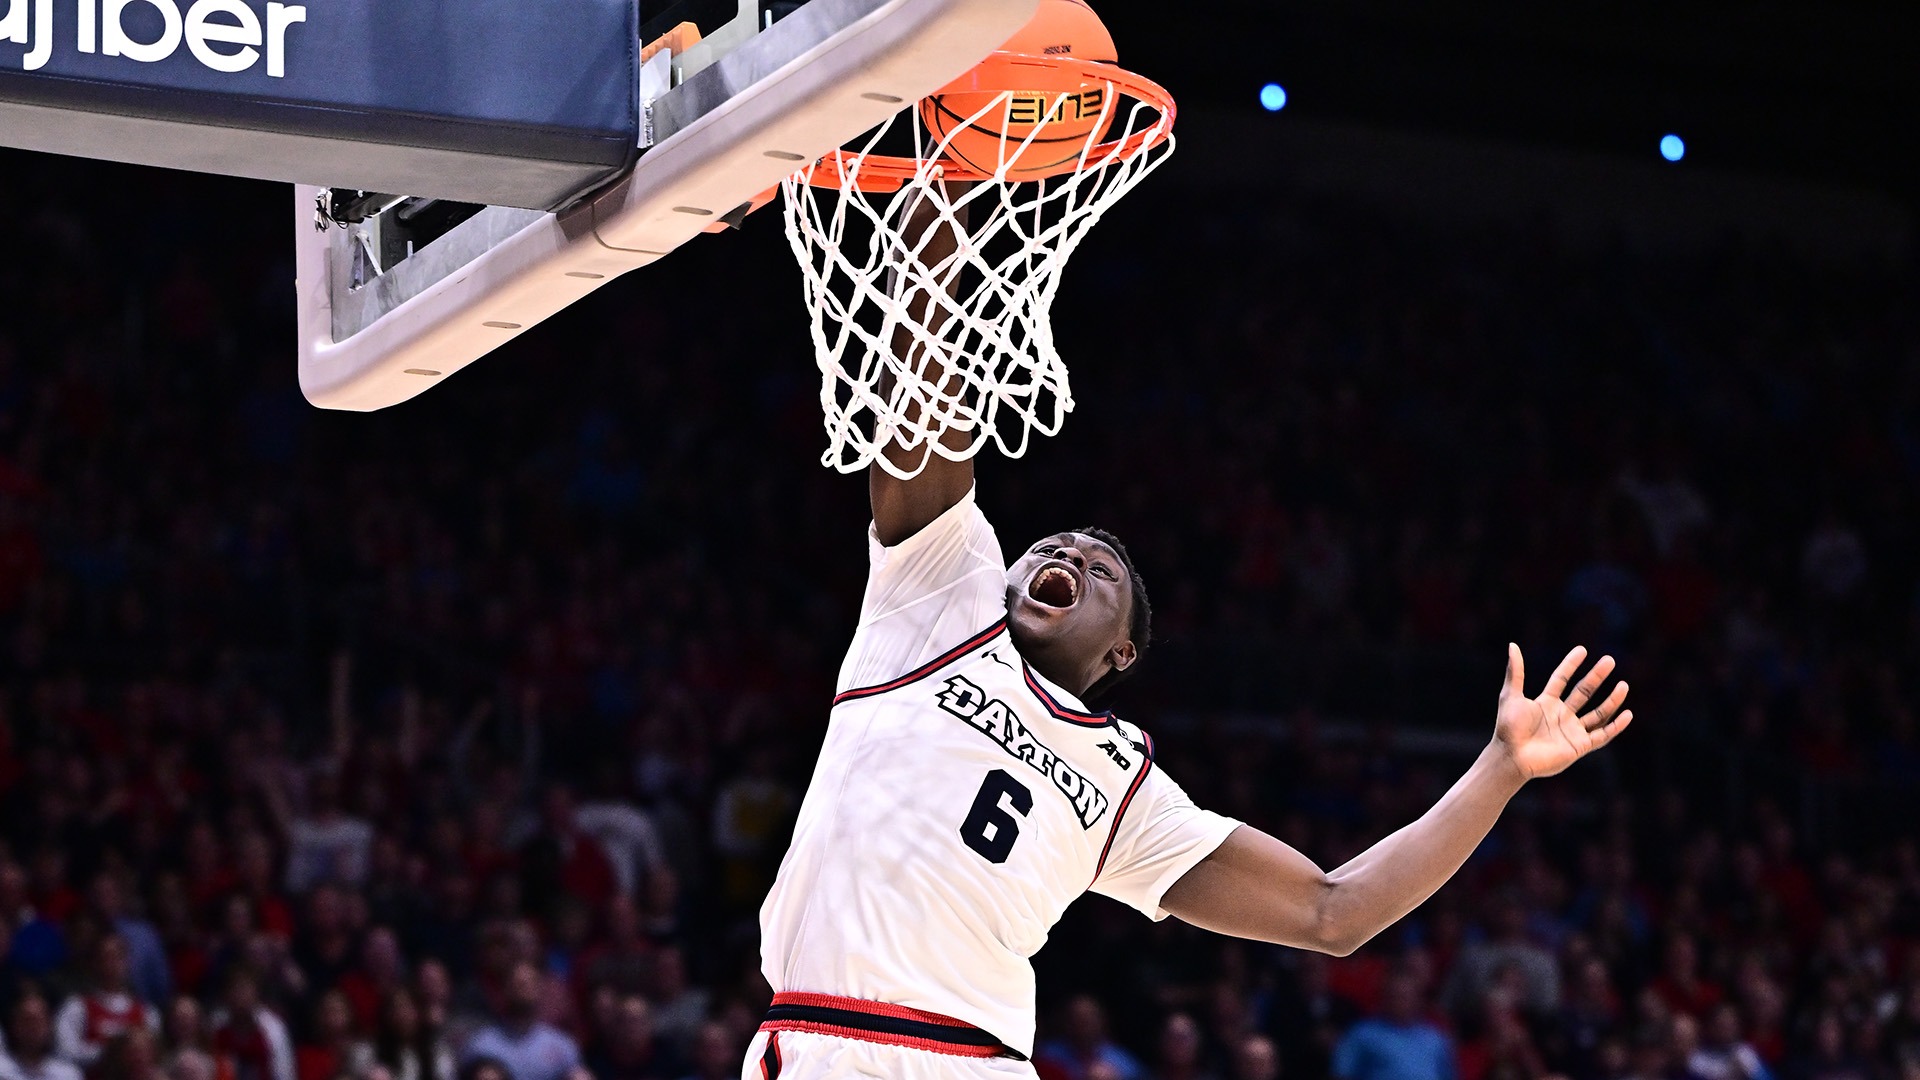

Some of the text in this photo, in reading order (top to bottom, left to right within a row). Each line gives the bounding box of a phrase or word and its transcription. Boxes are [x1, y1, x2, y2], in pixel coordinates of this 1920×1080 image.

[1008, 88, 1103, 124] ELITE
[935, 674, 1109, 831] DAYTON
[1096, 739, 1131, 771] A10
[959, 768, 1034, 864] 6
